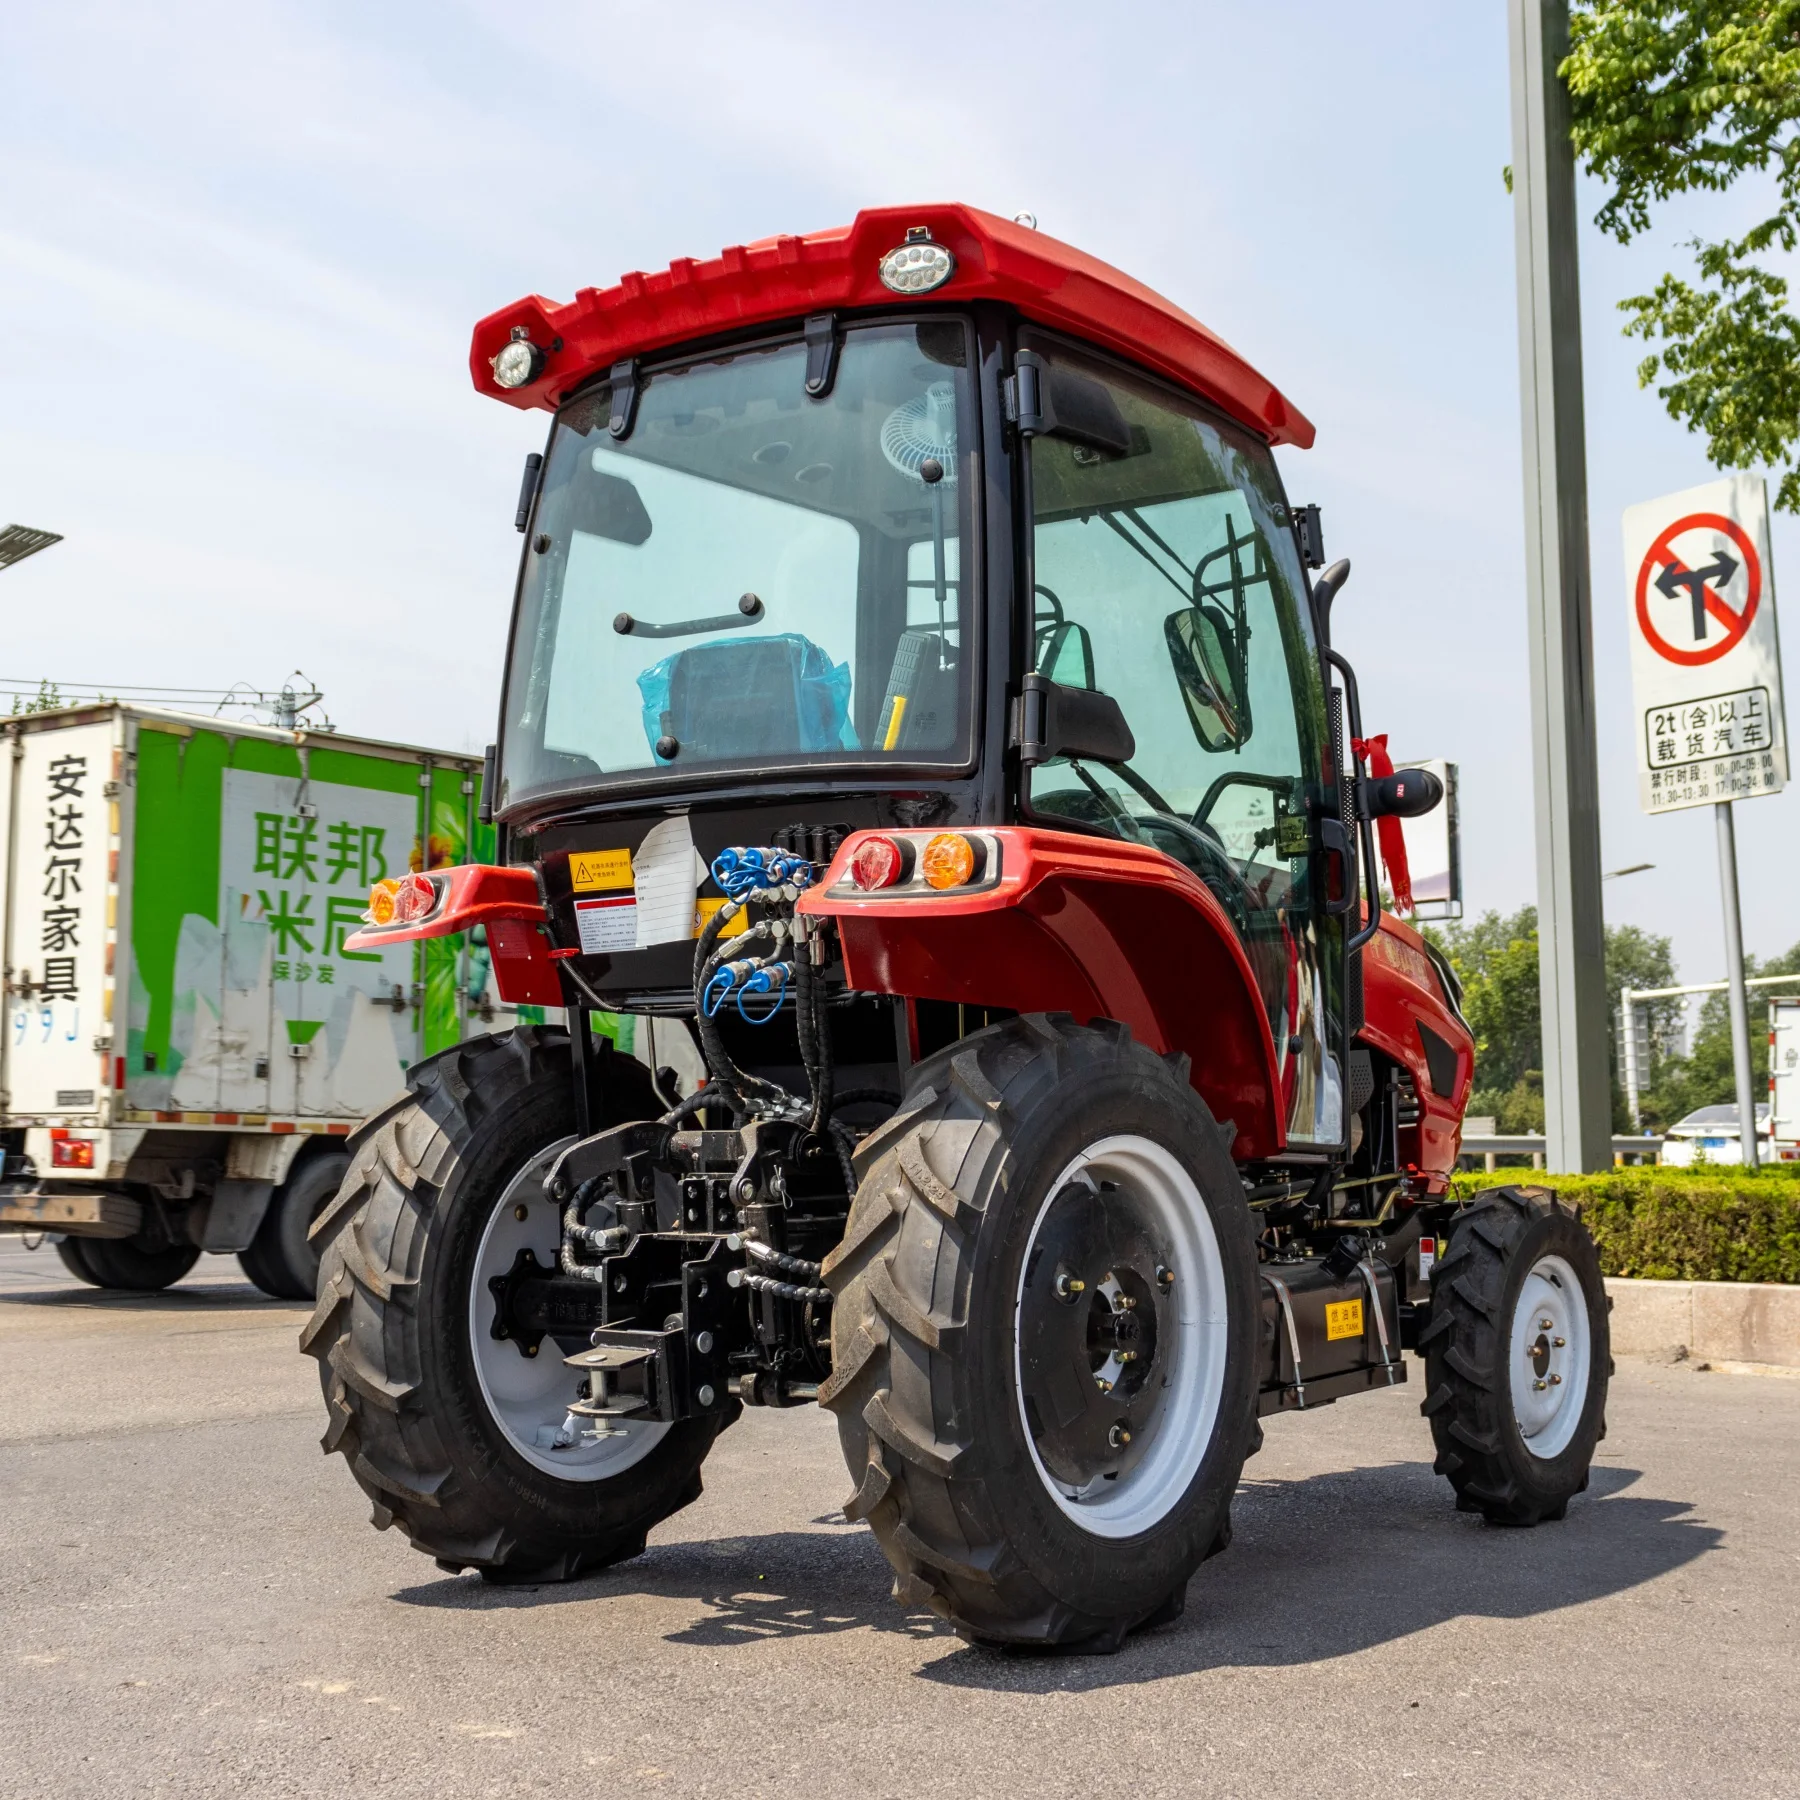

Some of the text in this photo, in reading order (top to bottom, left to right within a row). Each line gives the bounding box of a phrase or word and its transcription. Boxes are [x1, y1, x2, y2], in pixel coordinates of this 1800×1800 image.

[1657, 723, 1764, 761] 载货汽车
[40, 754, 88, 1003] 安达尔家具
[254, 811, 388, 889] 联邦
[1331, 1322, 1360, 1337] FUEL TANK
